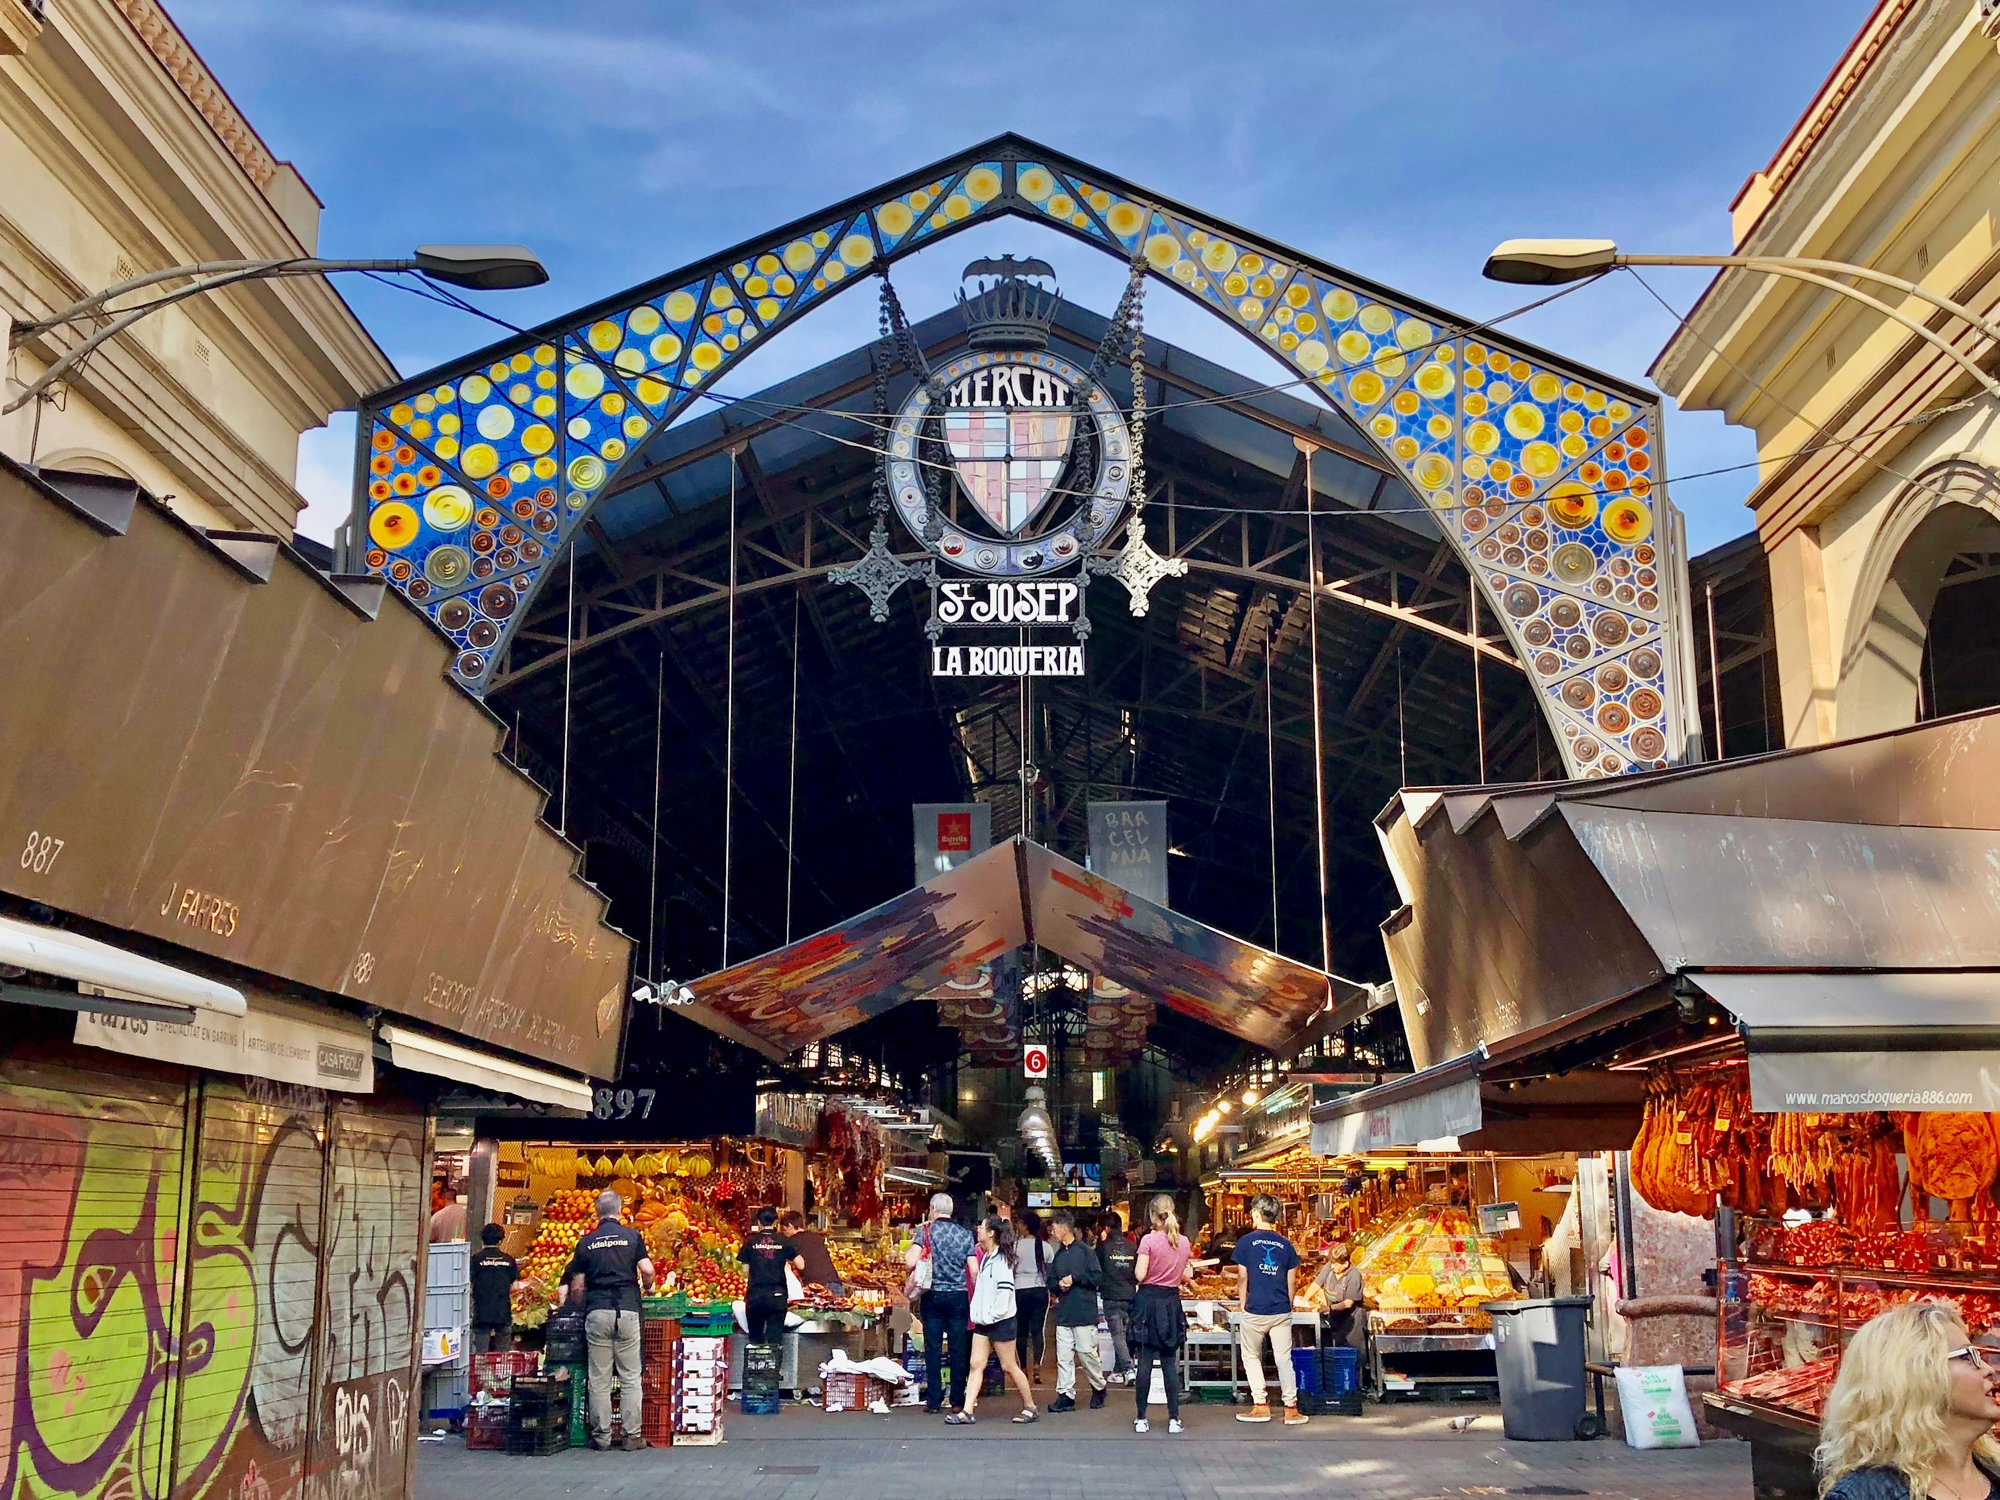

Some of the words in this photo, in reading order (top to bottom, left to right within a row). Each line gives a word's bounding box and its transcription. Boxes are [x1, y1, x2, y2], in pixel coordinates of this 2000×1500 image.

[949, 366, 1070, 406] MERCAT
[970, 583, 1078, 622] JOSEP
[932, 646, 963, 676] LA
[968, 646, 1084, 676] BOQUERIA
[1105, 811, 1149, 828] BAR
[20, 830, 65, 875] 887
[1109, 831, 1149, 847] CEL
[160, 882, 178, 917] J
[176, 888, 239, 937] FARRES
[352, 951, 376, 985] 888
[1031, 1053, 1041, 1070] 6
[593, 1087, 657, 1120] 897
[587, 1238, 629, 1251] vidalpons
[1258, 1263, 1279, 1272] CREW
